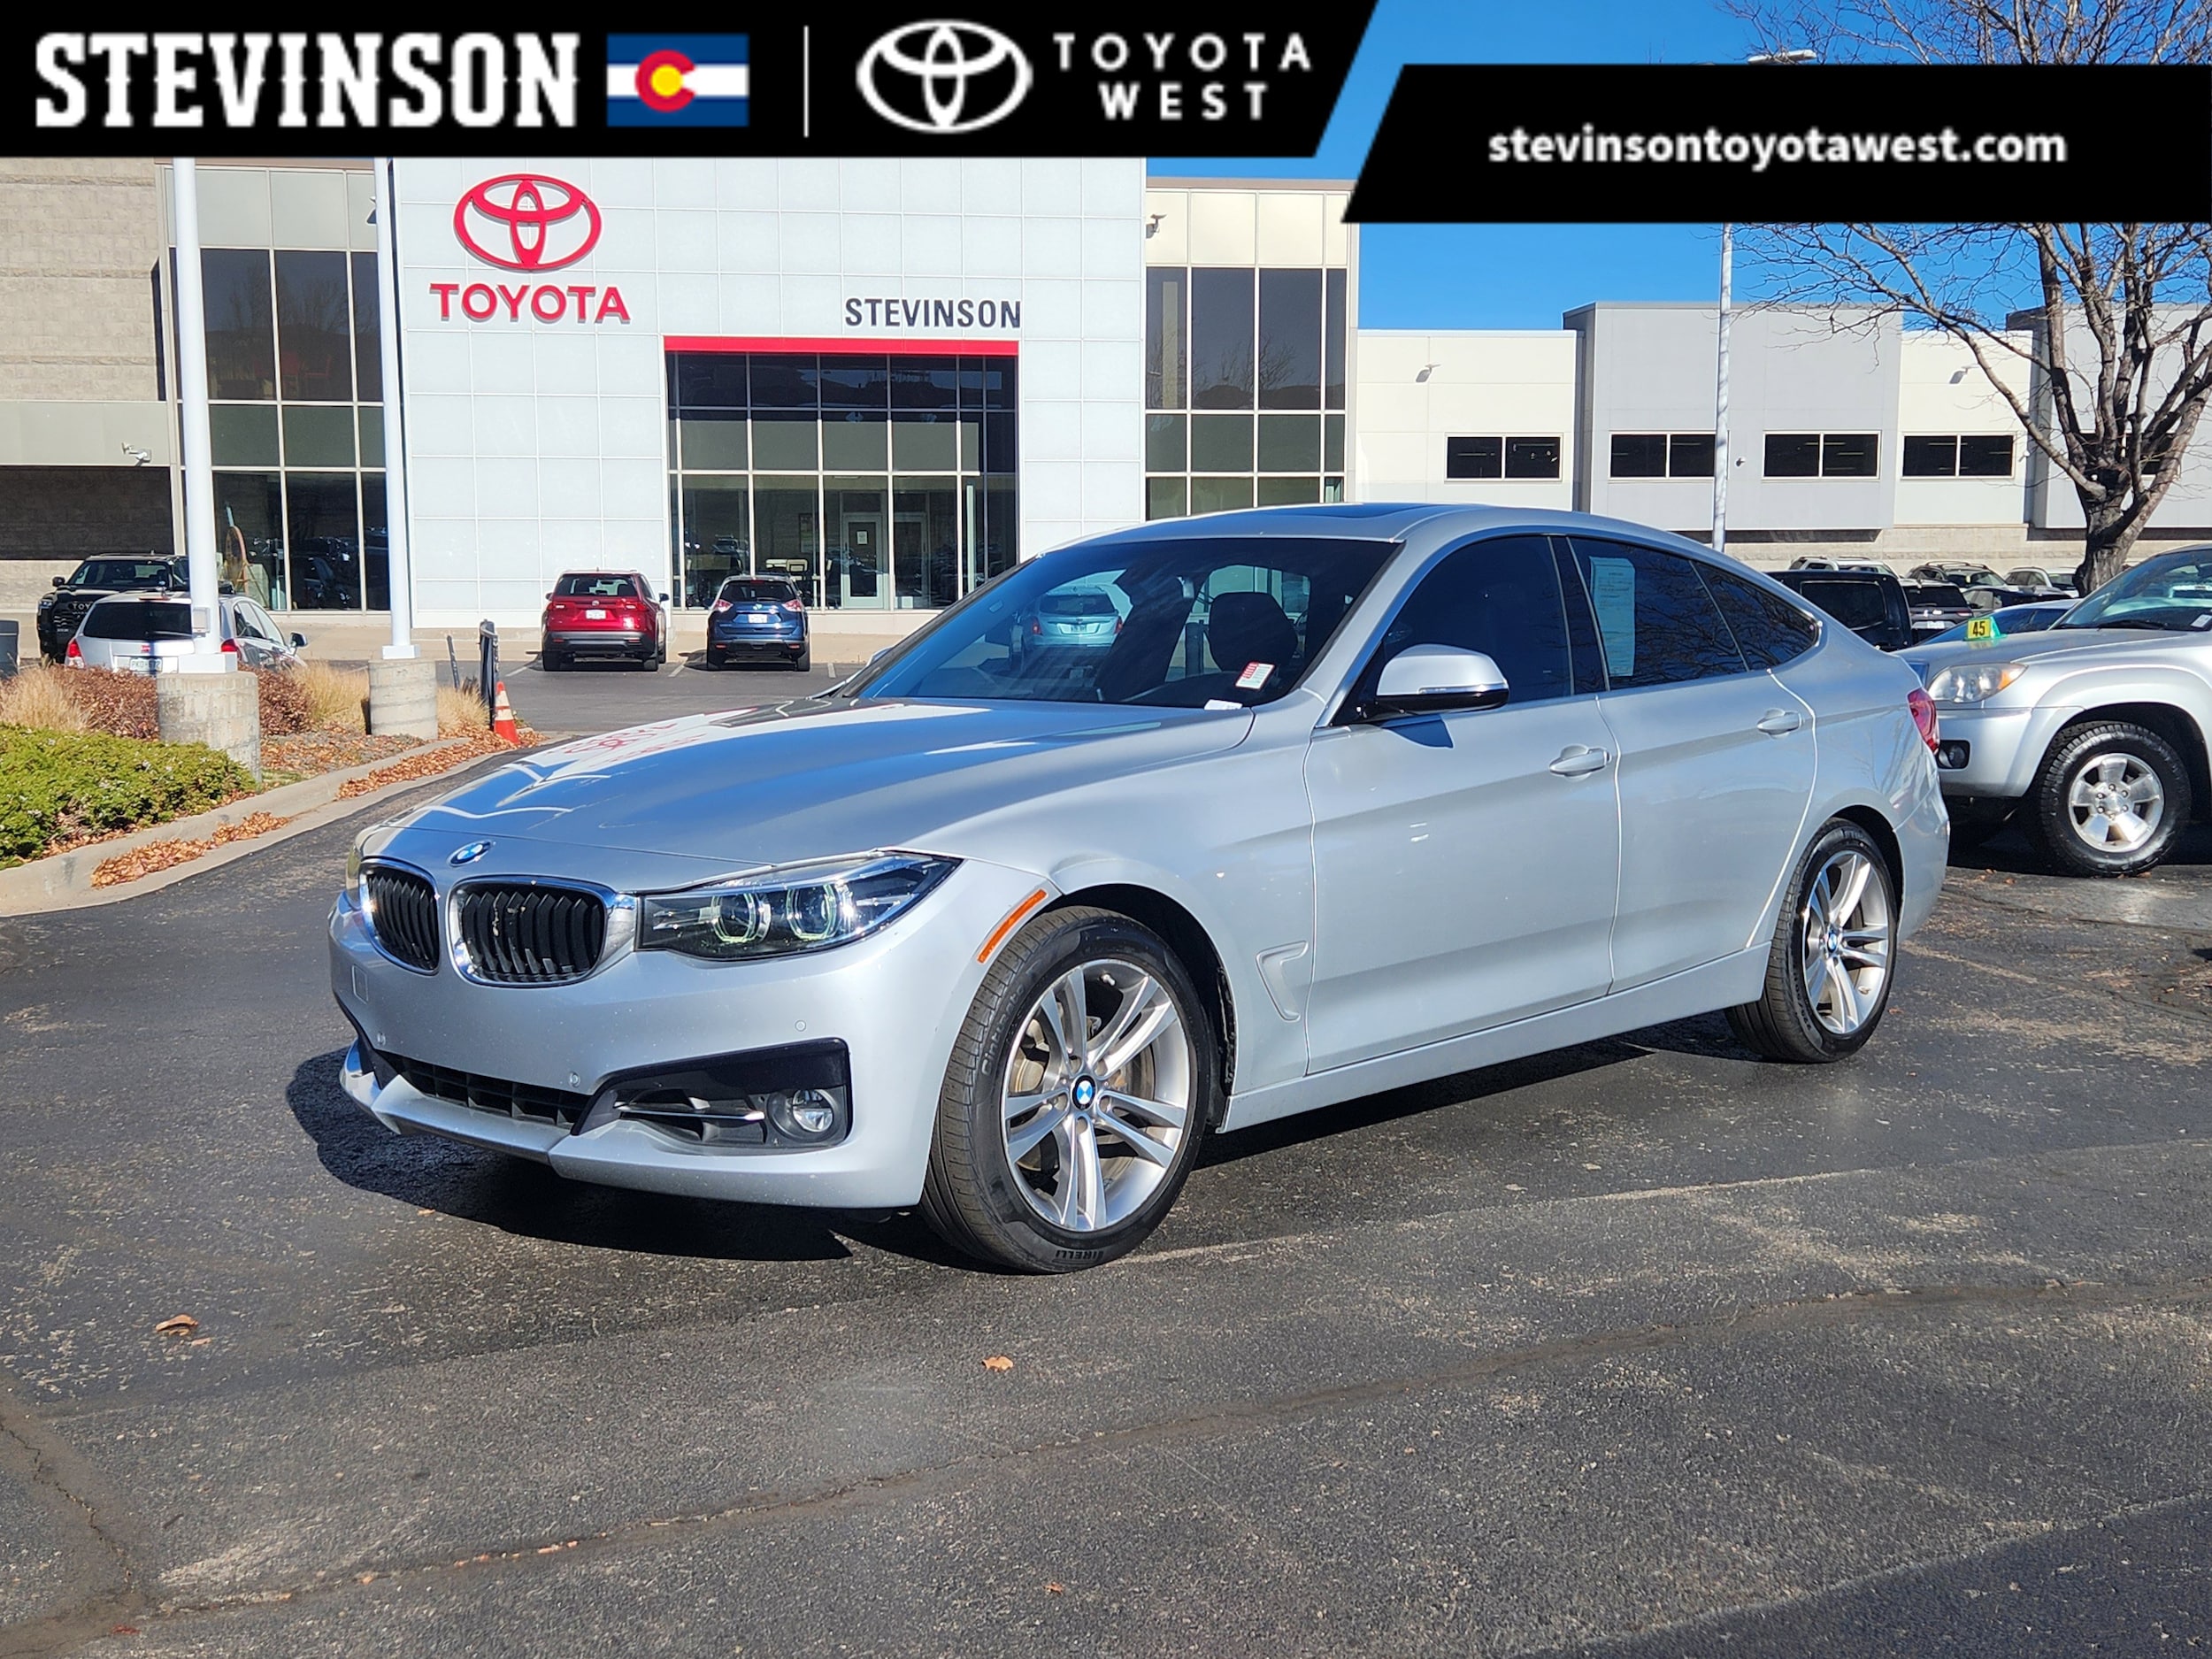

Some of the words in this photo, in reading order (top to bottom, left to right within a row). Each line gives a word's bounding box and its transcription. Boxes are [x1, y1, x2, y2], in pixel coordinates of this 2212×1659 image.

[430, 282, 631, 322] TOYOTA
[845, 297, 1021, 328] STEVINSON
[1972, 620, 1986, 636] 45
[1055, 1248, 1105, 1261] PIRELLI
